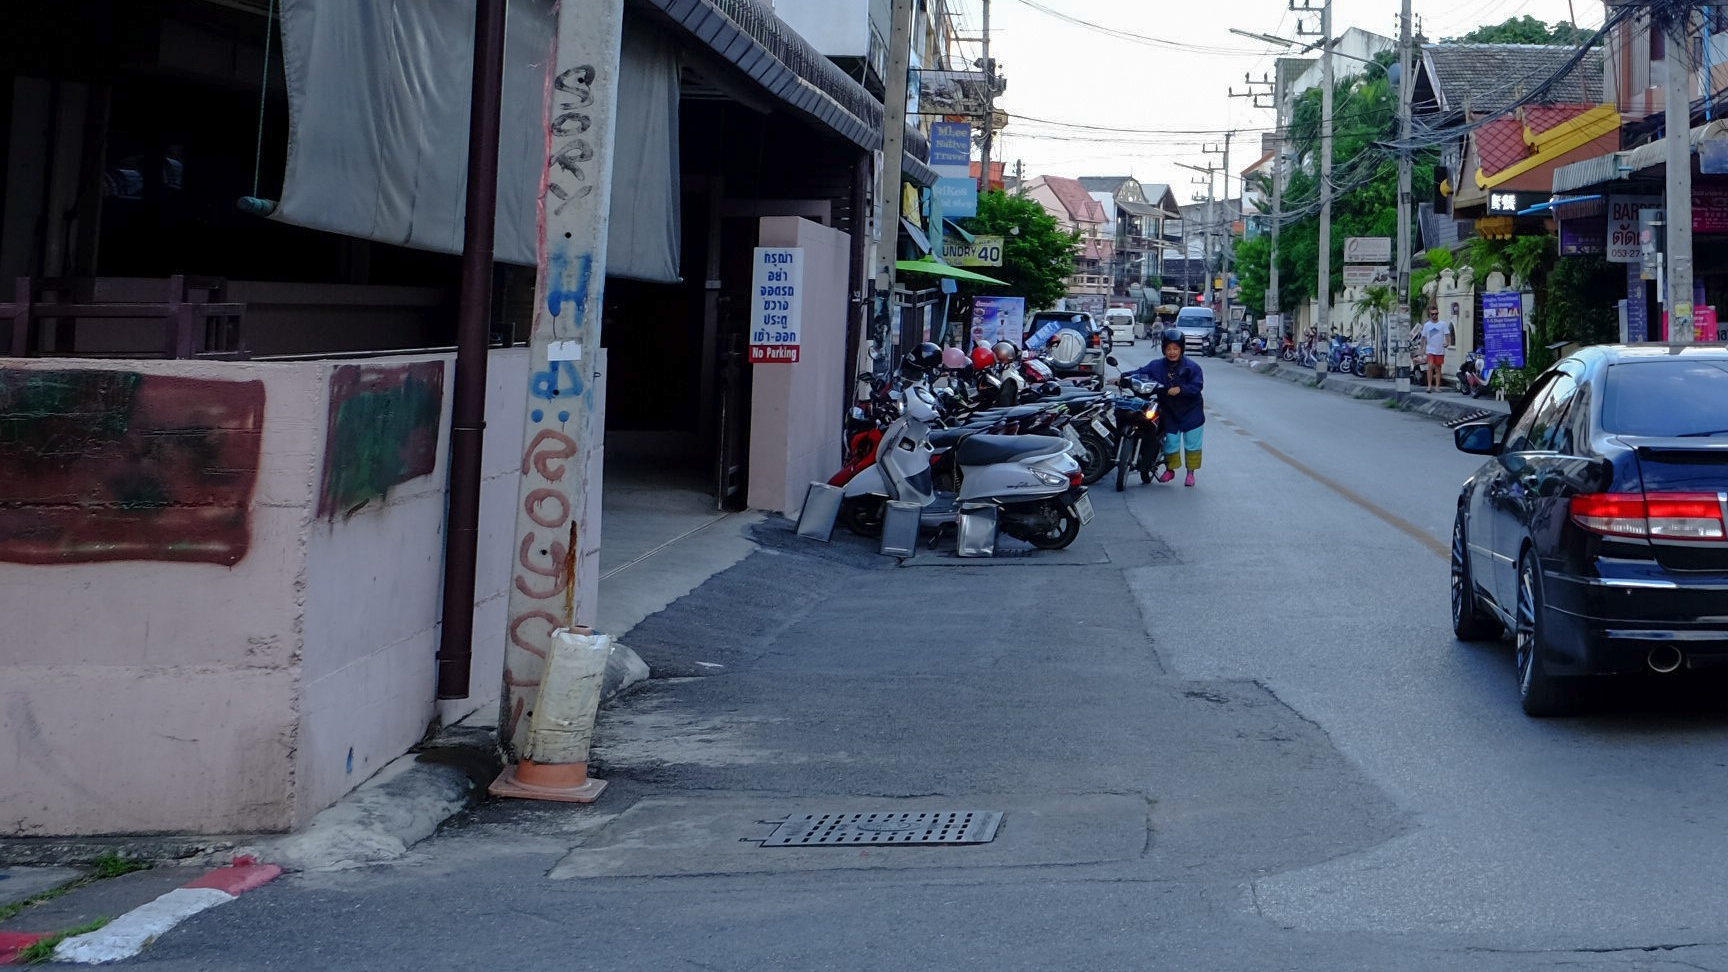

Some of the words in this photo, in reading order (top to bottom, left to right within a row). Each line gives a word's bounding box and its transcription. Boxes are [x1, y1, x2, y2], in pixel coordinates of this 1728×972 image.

[935, 139, 967, 150] Native
[934, 152, 966, 162] Travel
[764, 251, 793, 267] กรุณา
[943, 246, 977, 258] UNDRY
[978, 247, 1000, 262] 40
[768, 268, 788, 282] อย่า
[760, 286, 794, 297] จอดรถ
[763, 314, 788, 328] ประตู
[752, 347, 764, 359] No
[766, 347, 797, 361] Parking
